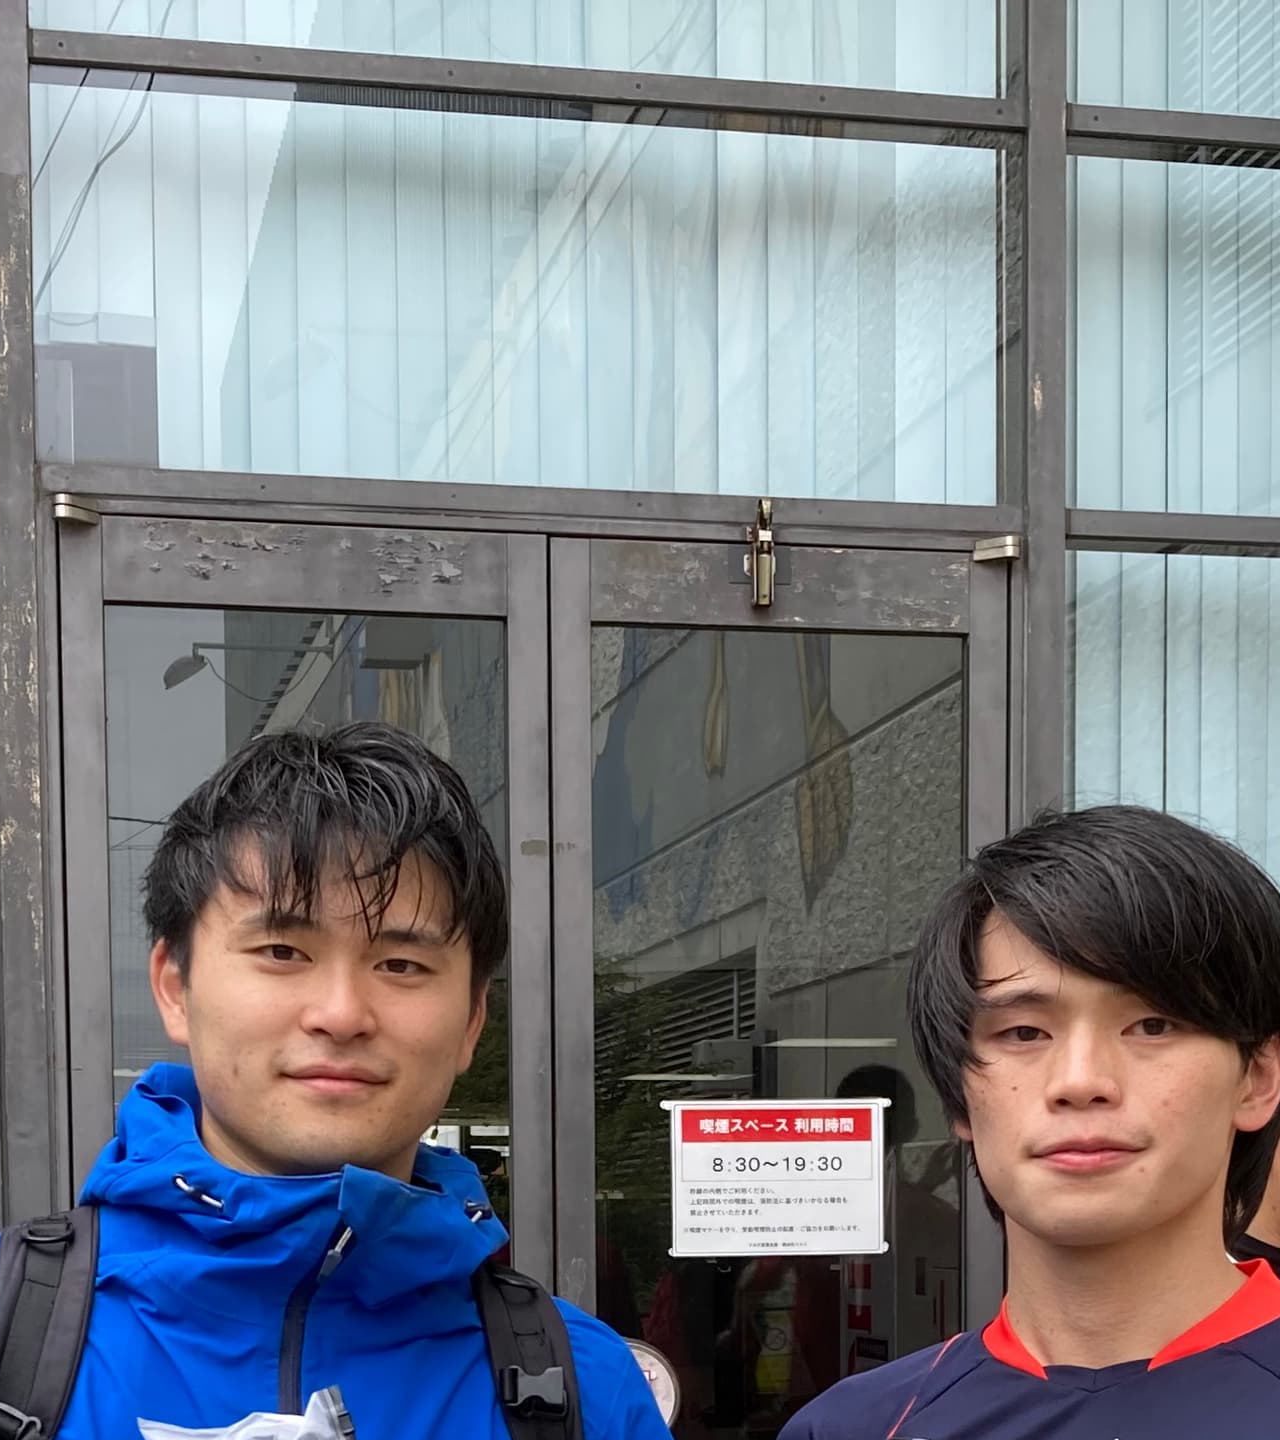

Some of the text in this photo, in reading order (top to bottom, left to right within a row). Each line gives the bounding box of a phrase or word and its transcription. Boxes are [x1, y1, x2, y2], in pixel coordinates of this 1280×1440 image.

[699, 1117, 854, 1134] 喫煙スペース 利用時間
